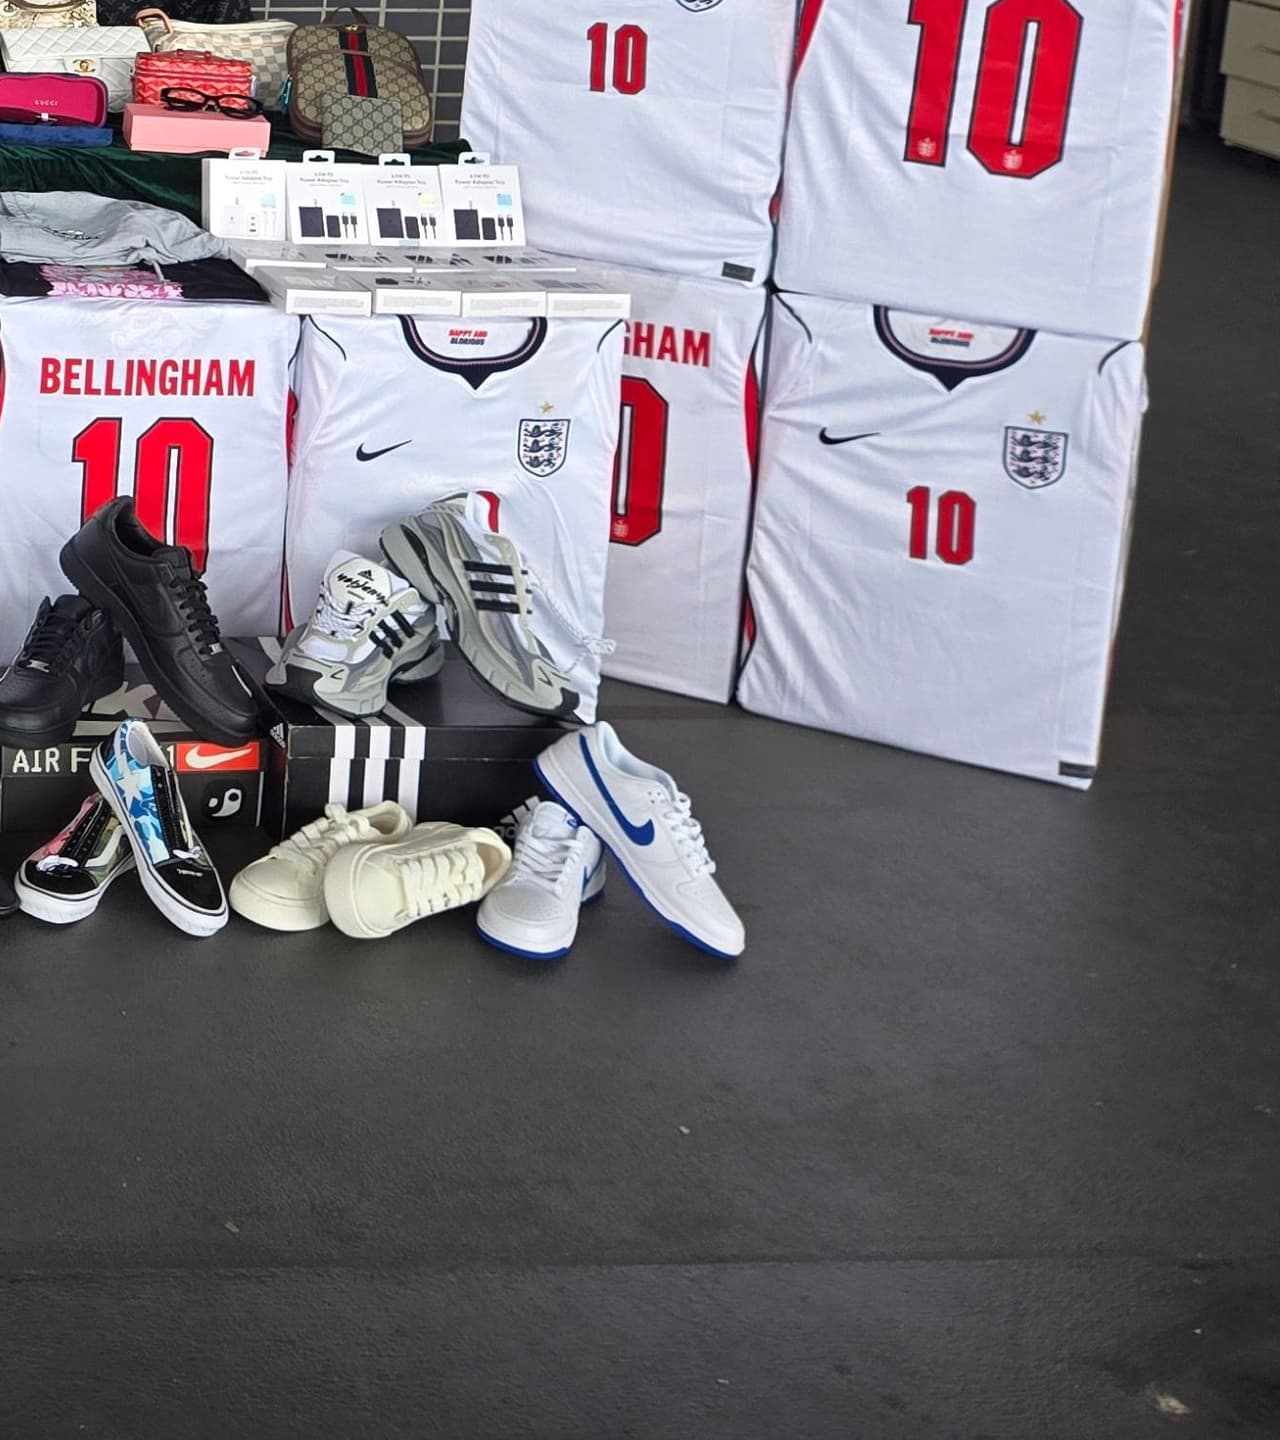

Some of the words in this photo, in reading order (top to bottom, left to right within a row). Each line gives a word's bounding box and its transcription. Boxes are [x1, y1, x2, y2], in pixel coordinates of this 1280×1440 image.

[585, 21, 648, 96] 10
[39, 357, 255, 397] BELLINGHAM
[906, 484, 977, 566] 10
[11, 746, 61, 774] AIR
